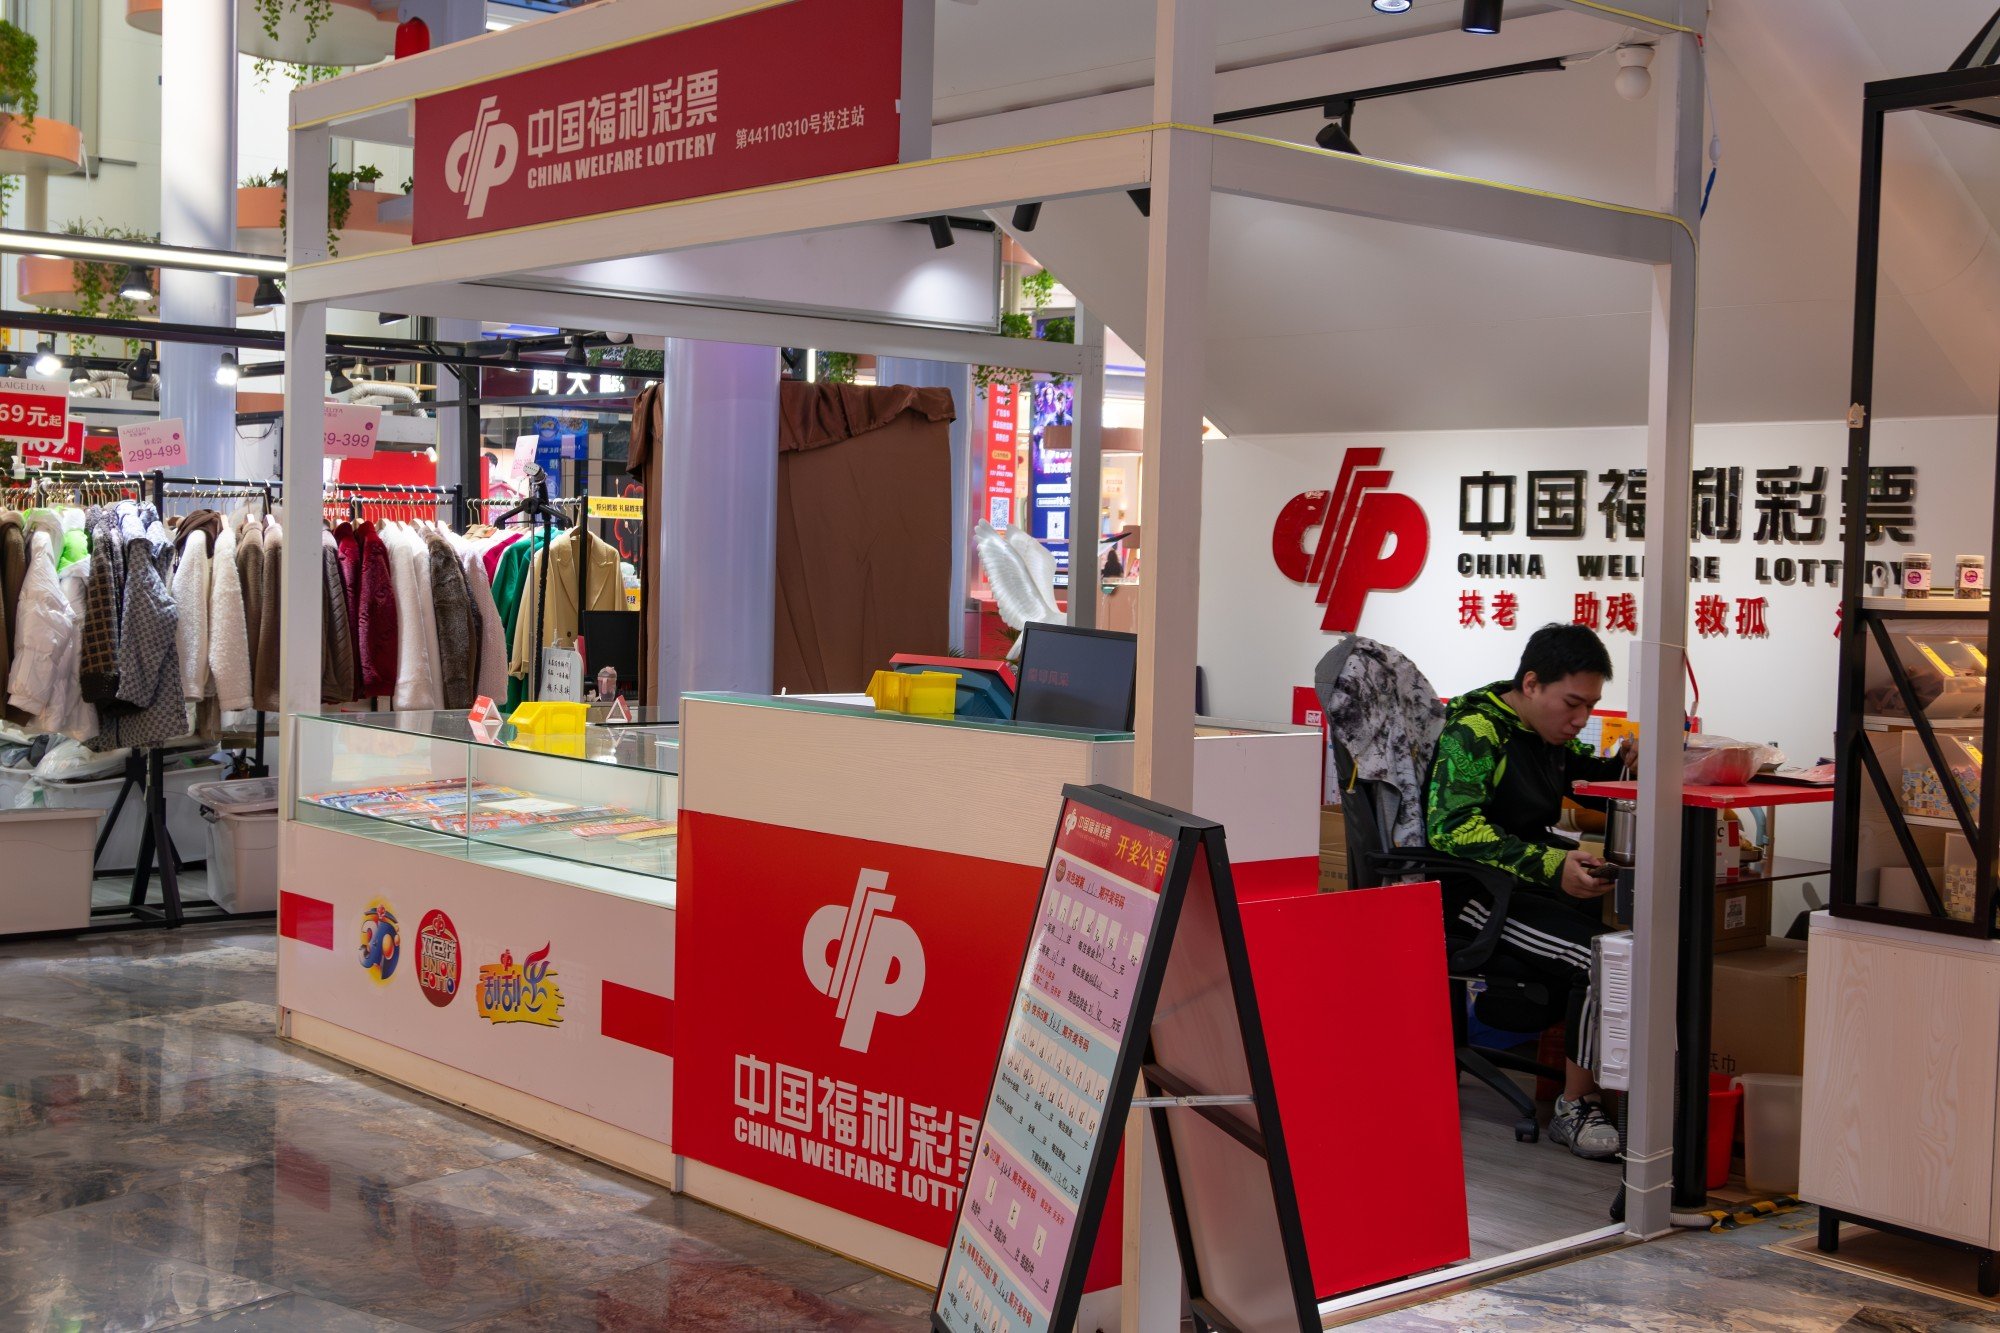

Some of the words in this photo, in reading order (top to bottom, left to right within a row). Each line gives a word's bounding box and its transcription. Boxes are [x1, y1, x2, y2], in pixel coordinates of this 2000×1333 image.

[527, 69, 718, 158] 中国福利彩票
[735, 104, 865, 149] 第44110310号投注站
[527, 161, 572, 188] CHINA
[575, 147, 643, 180] WELFARE
[647, 133, 716, 167] LOTTERY
[128, 444, 181, 462] 299-499
[324, 432, 370, 447] 9-399
[1457, 553, 1544, 577] CHINA
[1577, 555, 1720, 581] WELRE
[1459, 590, 1518, 628] 扶老
[1572, 592, 1638, 632] 助残
[1695, 594, 1767, 636] 救孤
[1115, 835, 1168, 876] 开奖公告
[421, 970, 456, 995] LOTTO
[422, 956, 458, 980] UNION
[484, 941, 551, 1013] 刮刮乐
[734, 1116, 796, 1159] CHINA
[801, 1137, 896, 1192] WELFARE
[902, 1169, 964, 1212] LOTT
